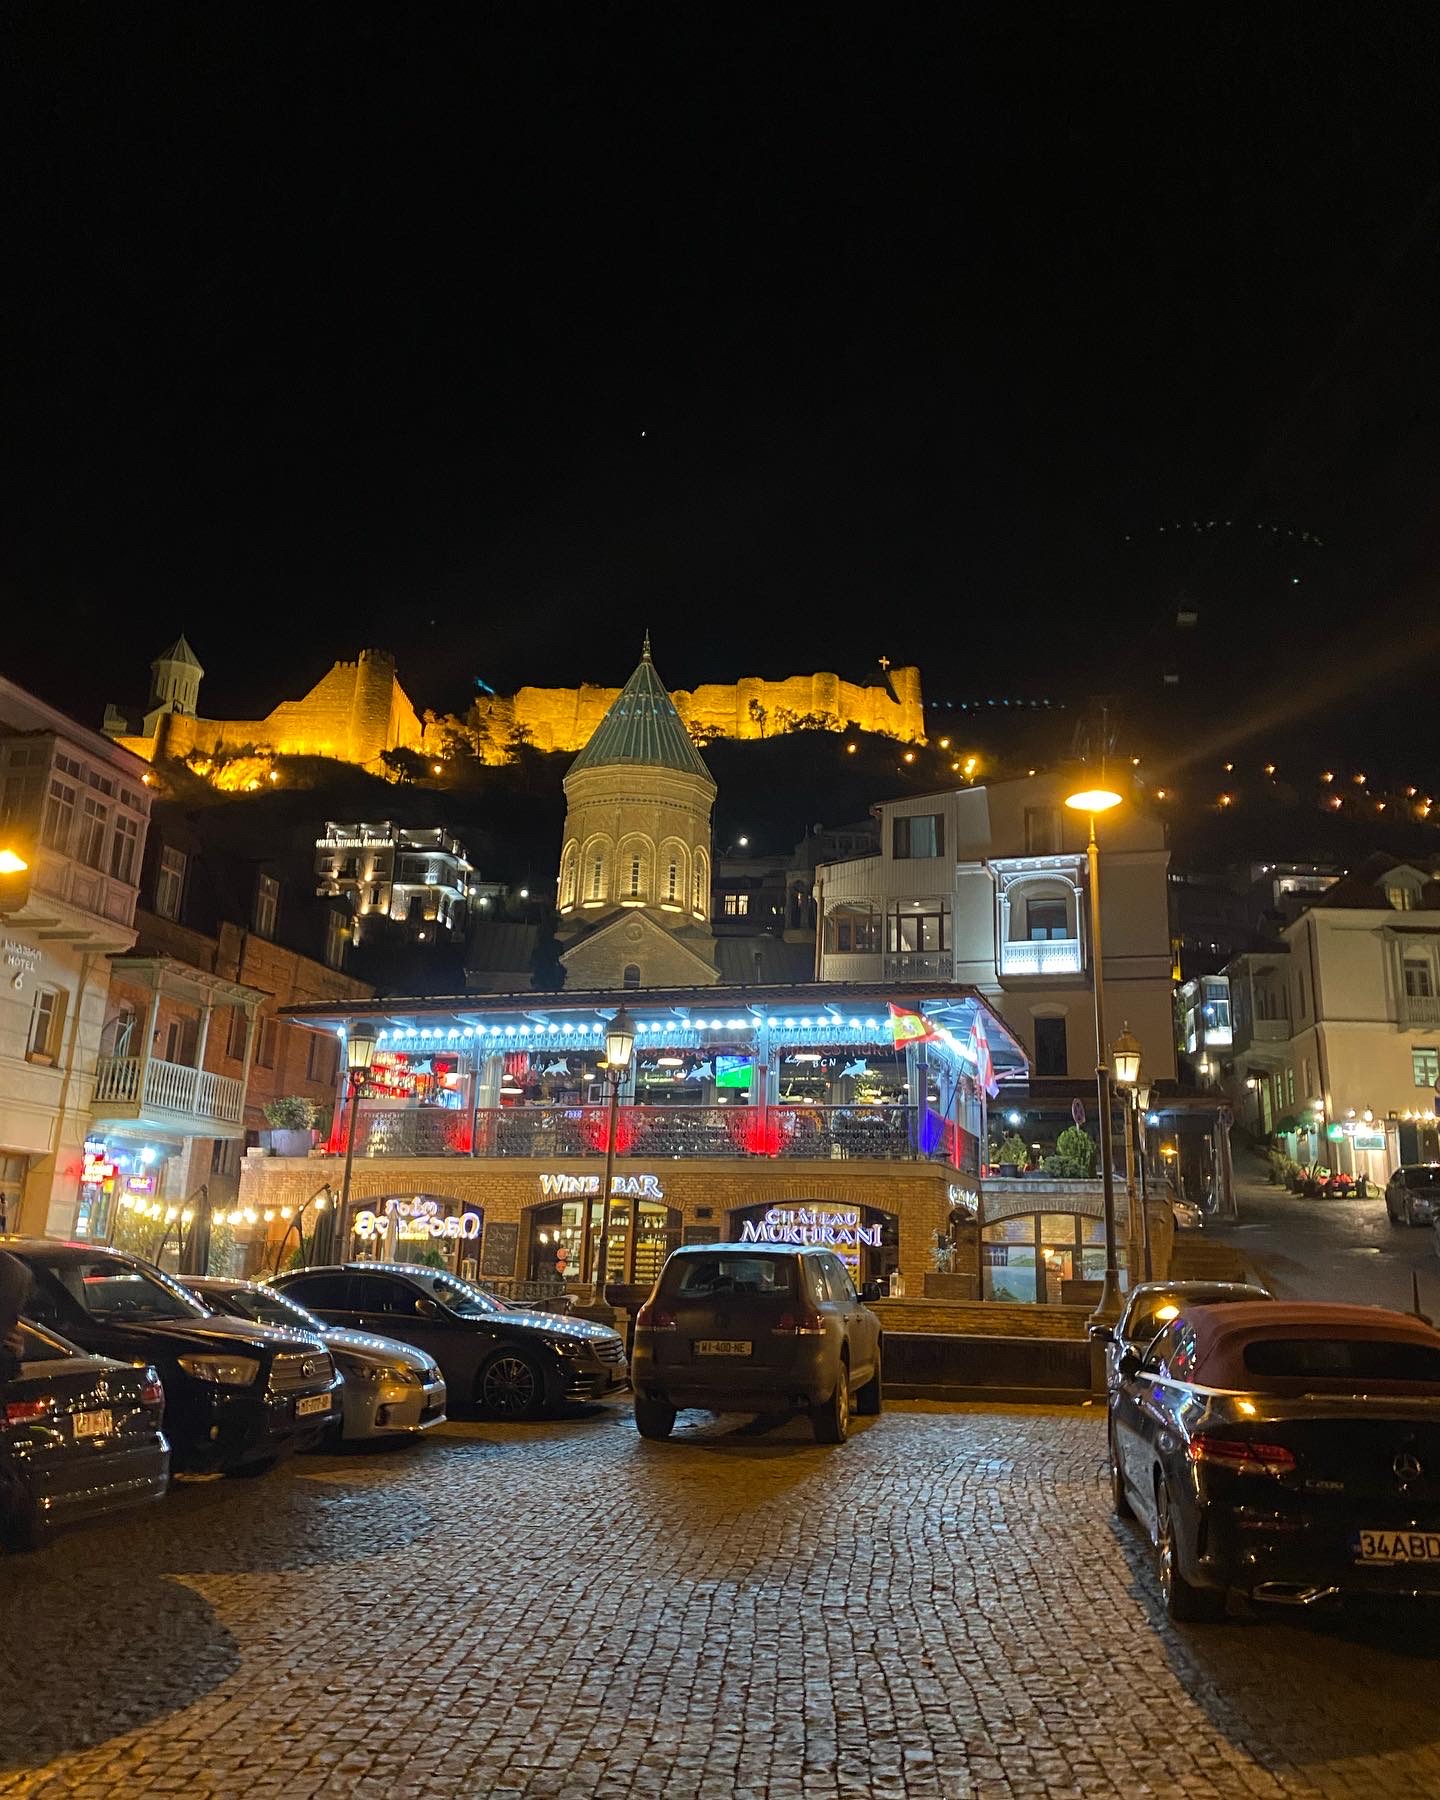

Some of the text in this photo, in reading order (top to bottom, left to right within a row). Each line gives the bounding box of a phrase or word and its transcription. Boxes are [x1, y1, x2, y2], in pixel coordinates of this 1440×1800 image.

[316, 838, 336, 848] HOTEL
[8, 955, 35, 972] HOTEL
[812, 1057, 837, 1069] BCN
[539, 1174, 664, 1198] WINE BAR
[738, 1220, 883, 1248] MUKHRANI
